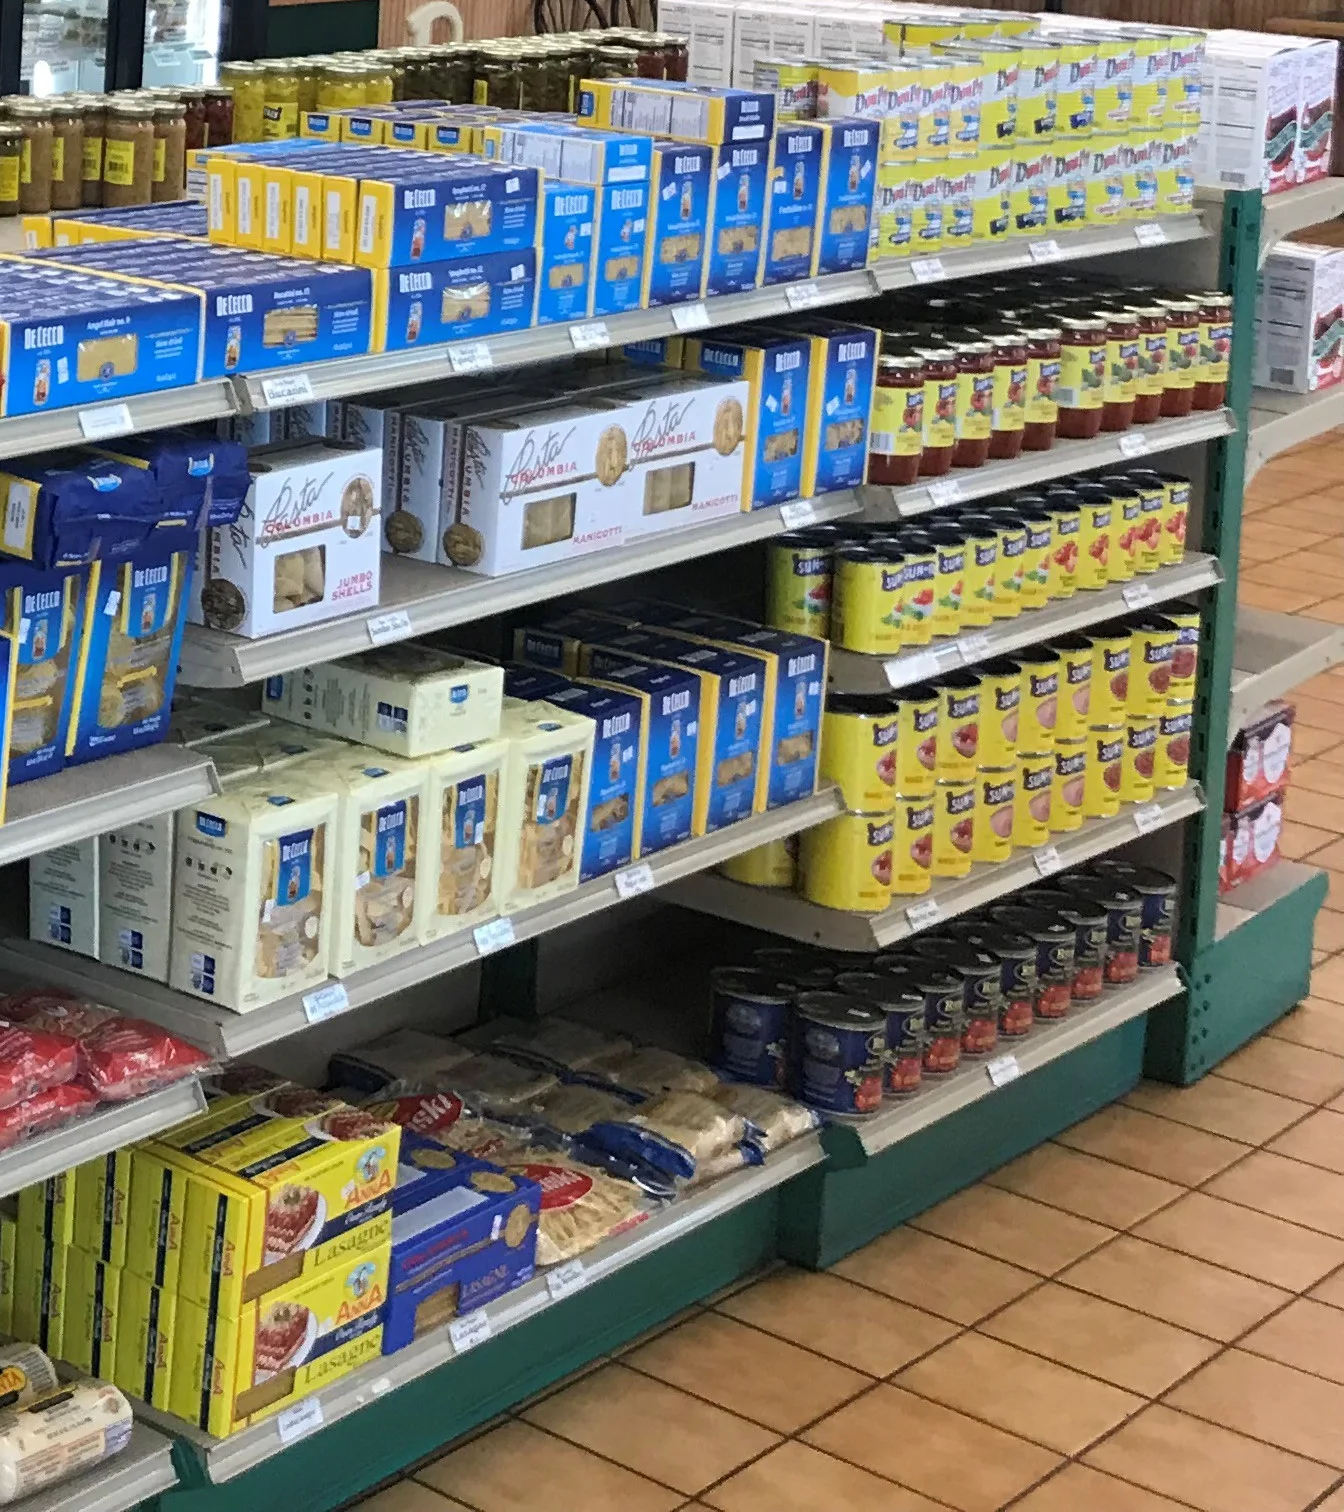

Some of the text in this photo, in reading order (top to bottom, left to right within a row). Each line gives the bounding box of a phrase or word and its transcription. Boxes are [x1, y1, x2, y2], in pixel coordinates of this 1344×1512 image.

[414, 189, 436, 208] CECCO
[228, 294, 253, 314] CECCO
[25, 325, 64, 349] DE CECCO
[634, 431, 697, 454] COLOMBIA
[512, 461, 578, 486] COLOMBIA
[691, 494, 739, 513] MANICOTTI
[266, 511, 334, 534] COLOMBIA
[573, 526, 622, 546] MANICOTTI
[135, 565, 168, 588] DE CECCO
[338, 571, 373, 586] JUMBO
[25, 590, 60, 614] DE CECCO
[331, 582, 373, 602] SHELLS
[314, 1219, 388, 1267] Lasagne
[305, 1334, 381, 1384] Lasagne
